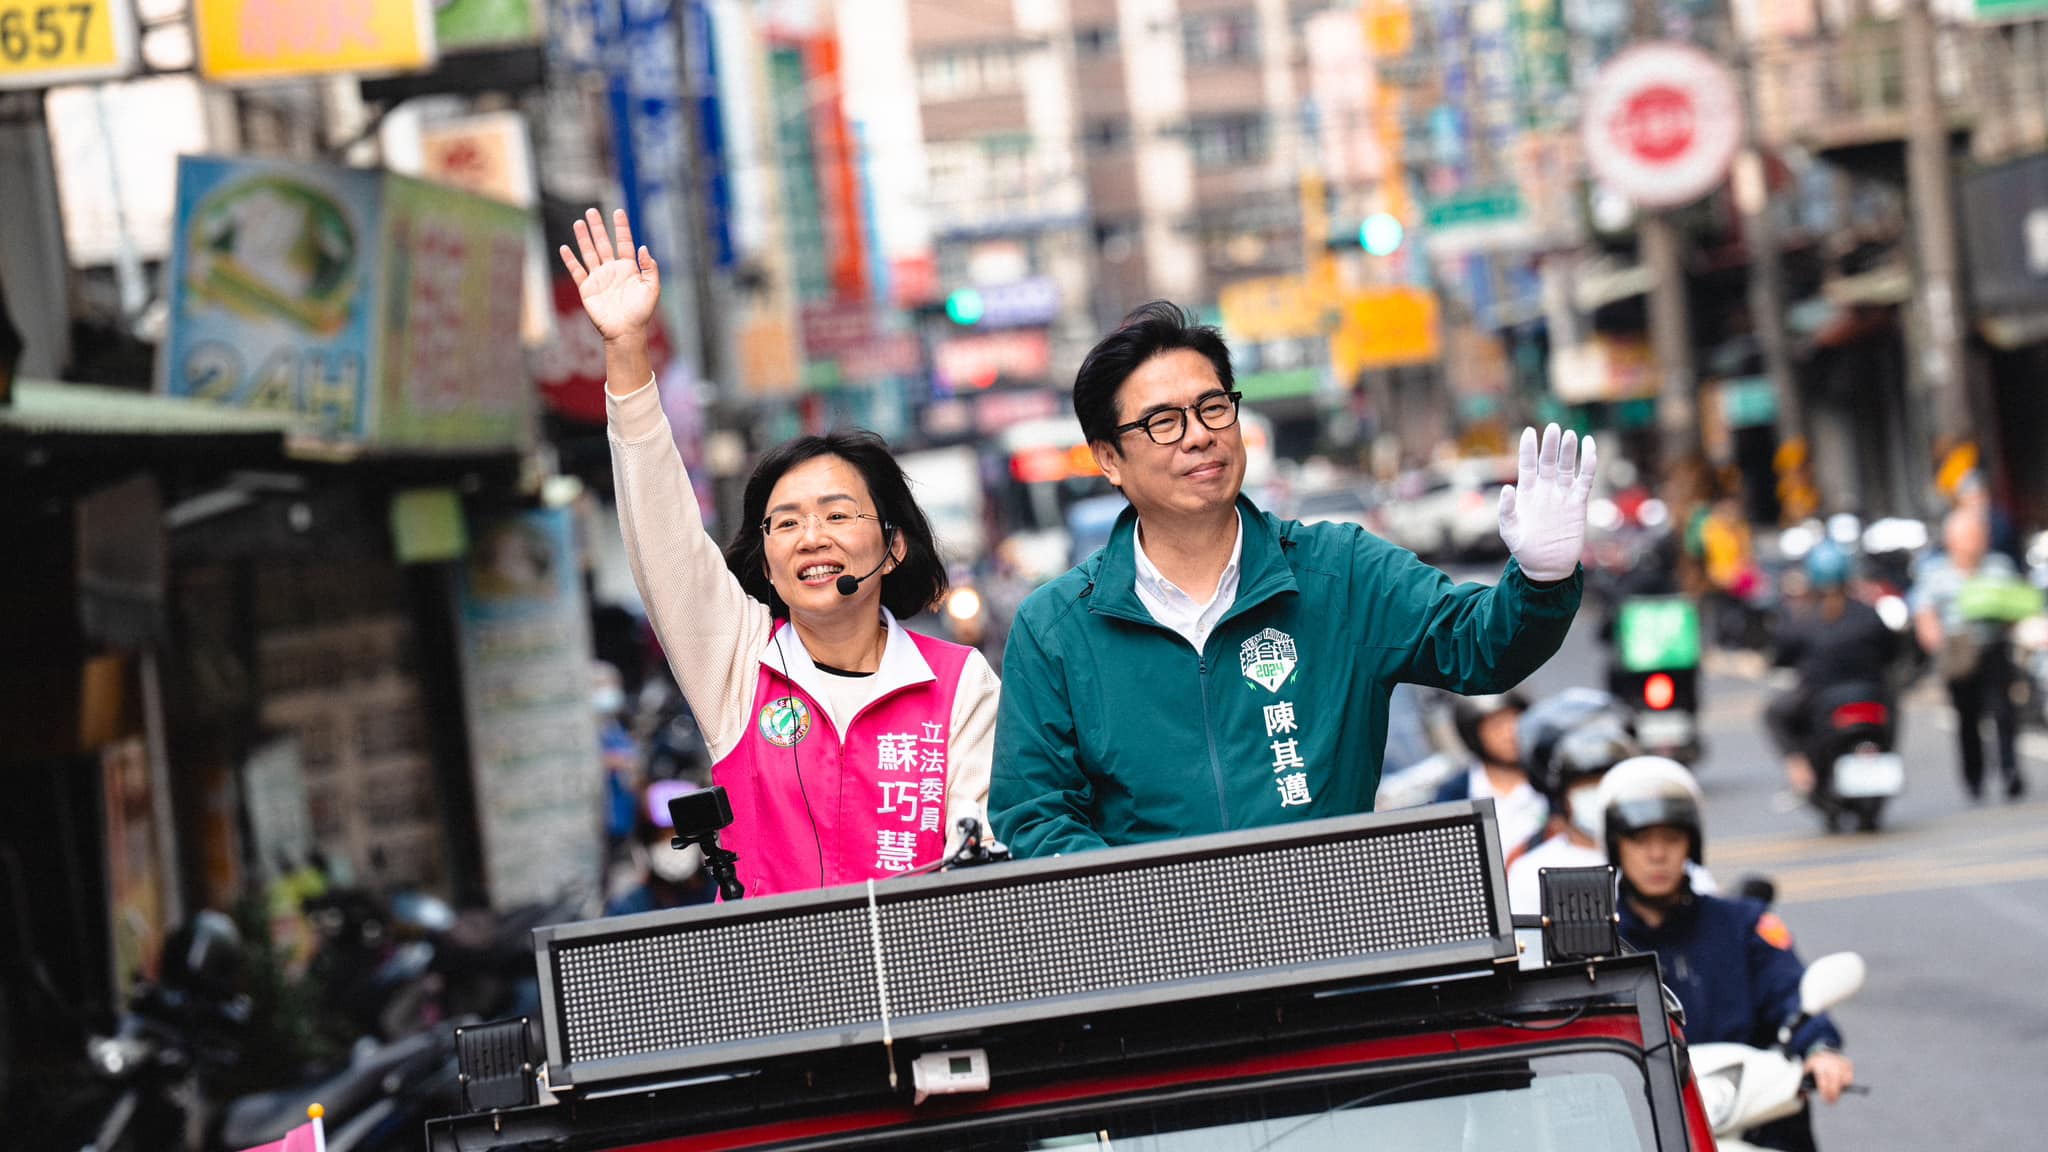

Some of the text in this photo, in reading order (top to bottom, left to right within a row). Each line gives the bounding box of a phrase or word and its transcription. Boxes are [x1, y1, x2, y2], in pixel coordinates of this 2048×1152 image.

[1241, 627, 1291, 650] TEAM TAIWAN
[1241, 640, 1297, 673] 挺台灣
[1255, 661, 1285, 678] 2024
[919, 720, 945, 834] 立法委員
[1263, 700, 1312, 808] 陳其邁
[875, 732, 918, 872] 蘇巧慧
